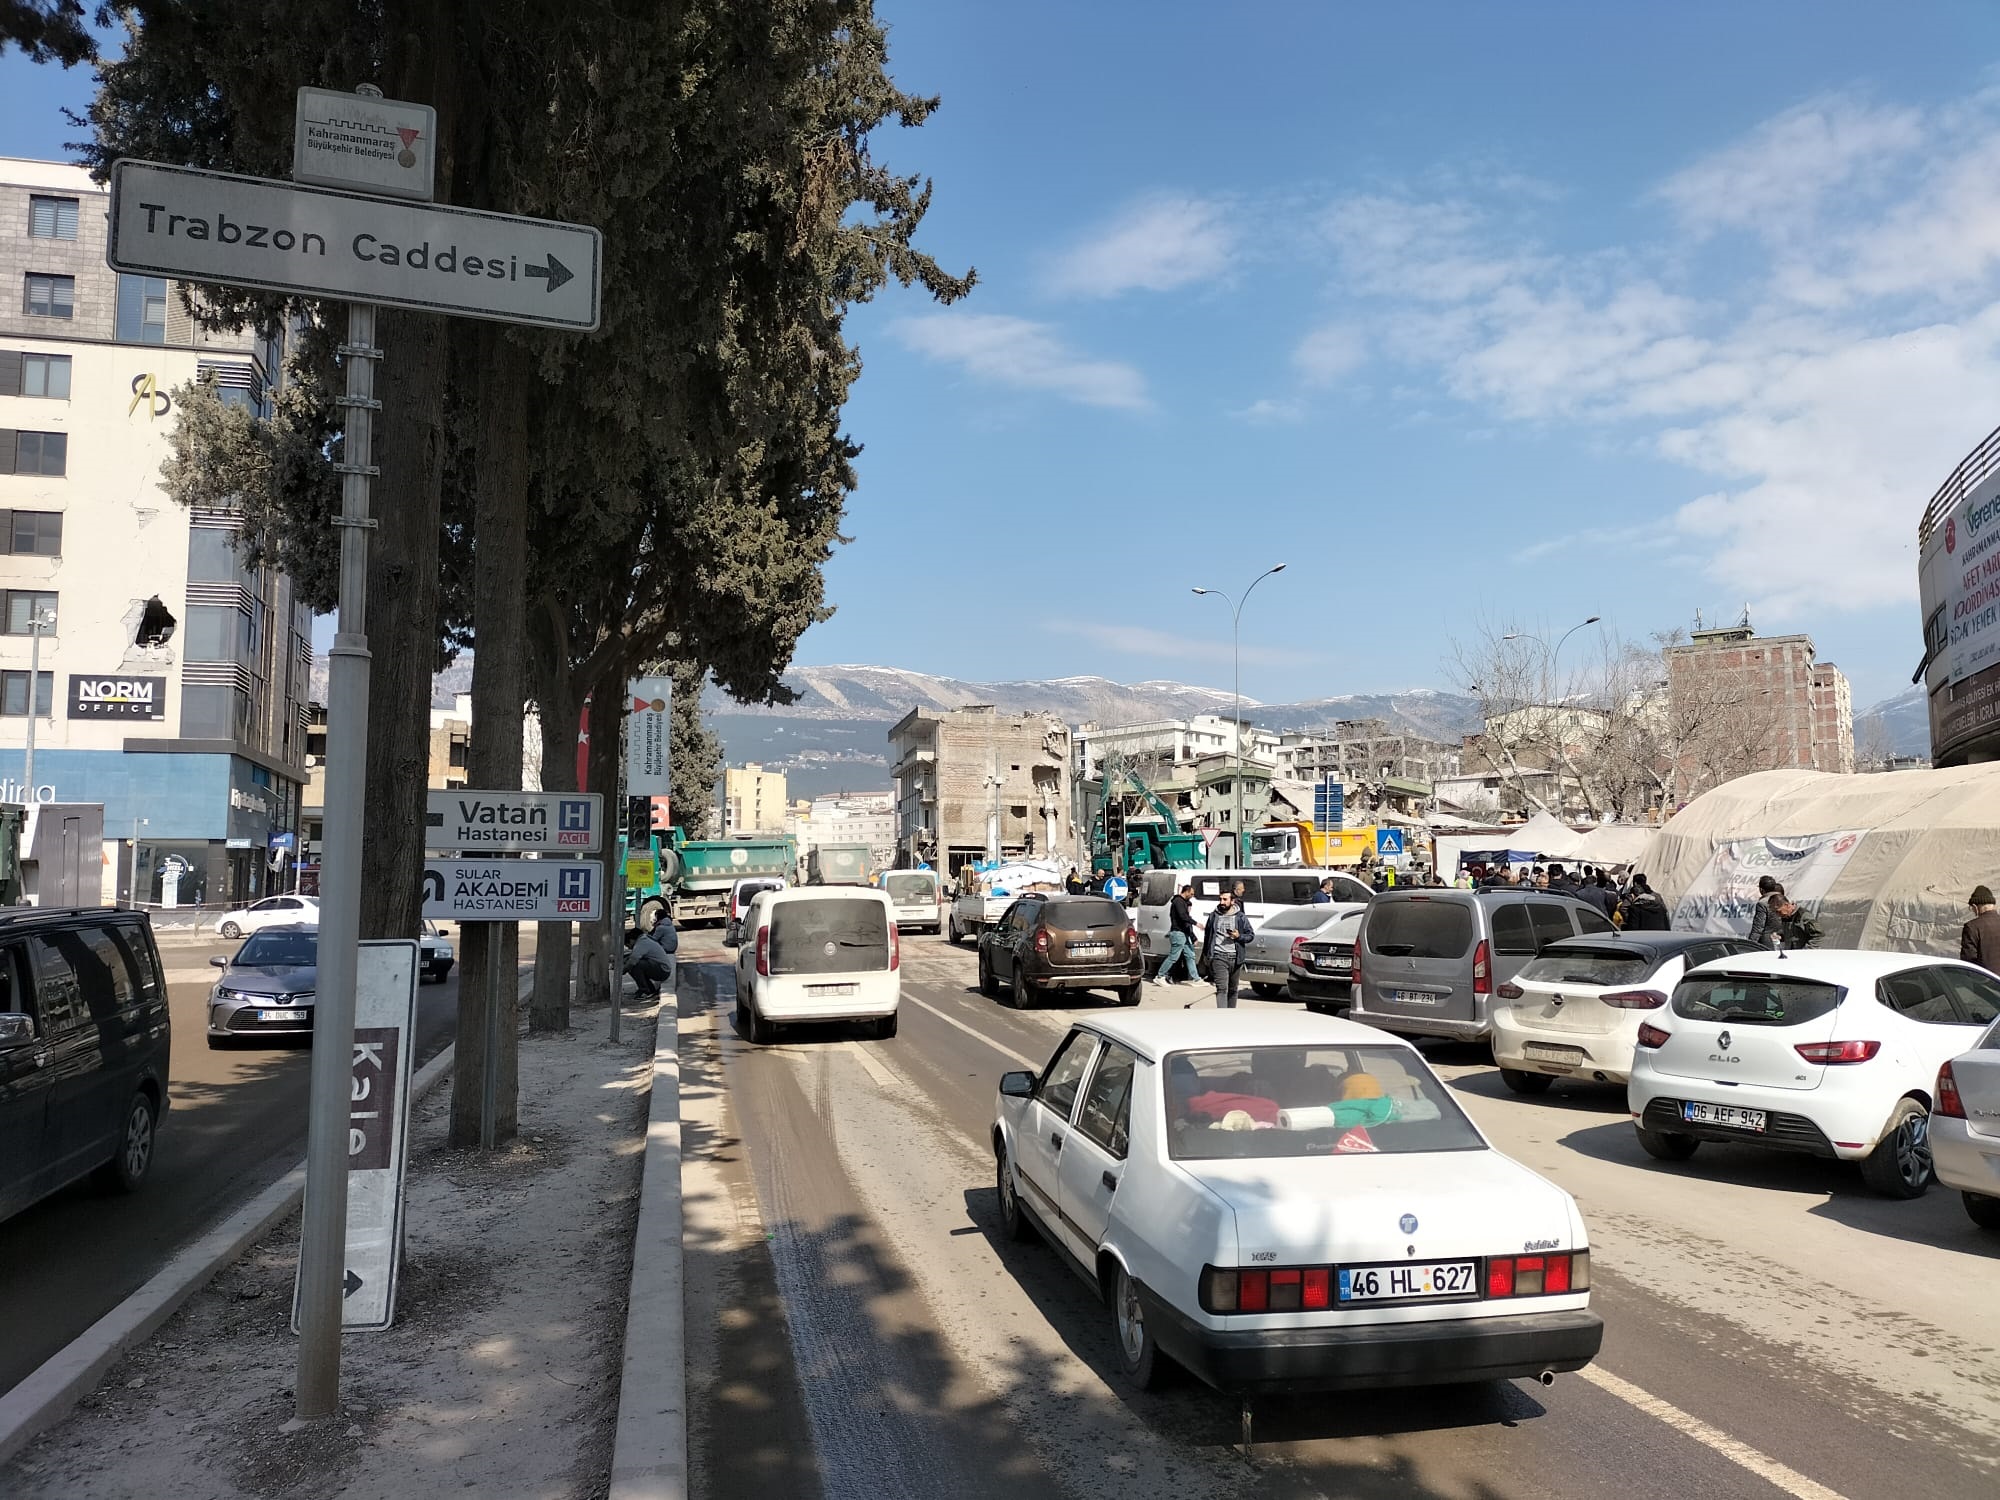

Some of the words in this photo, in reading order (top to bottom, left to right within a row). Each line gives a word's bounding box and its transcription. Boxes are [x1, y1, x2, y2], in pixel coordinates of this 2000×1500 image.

[308, 126, 396, 151] Kahramanmaraş
[307, 138, 353, 154] Büyükşehir
[354, 145, 396, 160] Belediyesi
[139, 202, 327, 256] Trabzon
[352, 233, 517, 282] Caddesi
[79, 680, 153, 698] NORM
[78, 703, 153, 713] OFFICE
[458, 800, 547, 825] Vatan
[457, 826, 548, 842] Hastanesi
[455, 868, 502, 880] SULAR
[454, 879, 549, 898] AKADEMİ
[453, 896, 539, 911] HASTANESİ
[1693, 1104, 1708, 1119] 06
[1713, 1106, 1735, 1123] AEF
[1740, 1110, 1764, 1127] 942
[1352, 1271, 1379, 1297] 46
[1390, 1269, 1421, 1294] HL
[1432, 1265, 1473, 1291] 627
